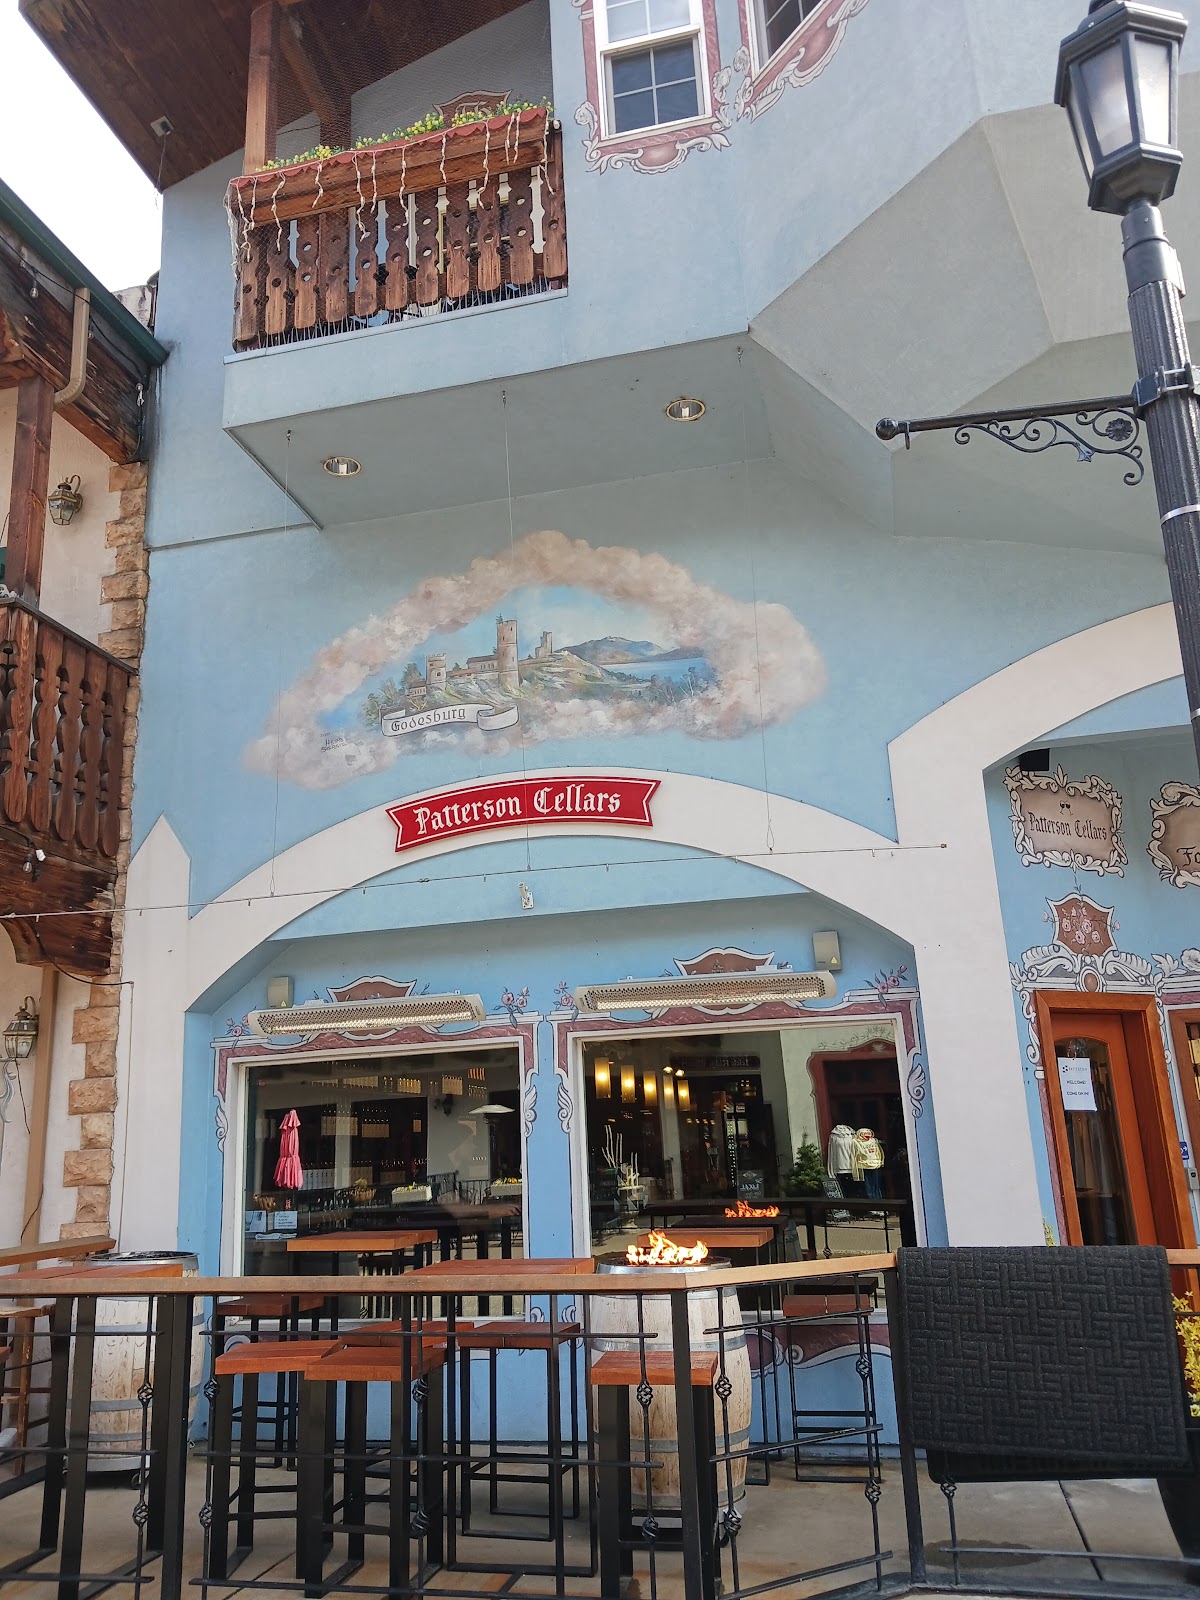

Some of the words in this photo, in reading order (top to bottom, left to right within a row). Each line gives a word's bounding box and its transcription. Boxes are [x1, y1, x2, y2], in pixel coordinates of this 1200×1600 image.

[391, 707, 466, 732] Godesburg
[413, 795, 522, 835] Patterson
[533, 783, 621, 814] Cellars
[1028, 811, 1072, 837] Patterson
[1074, 819, 1108, 841] Cellars
